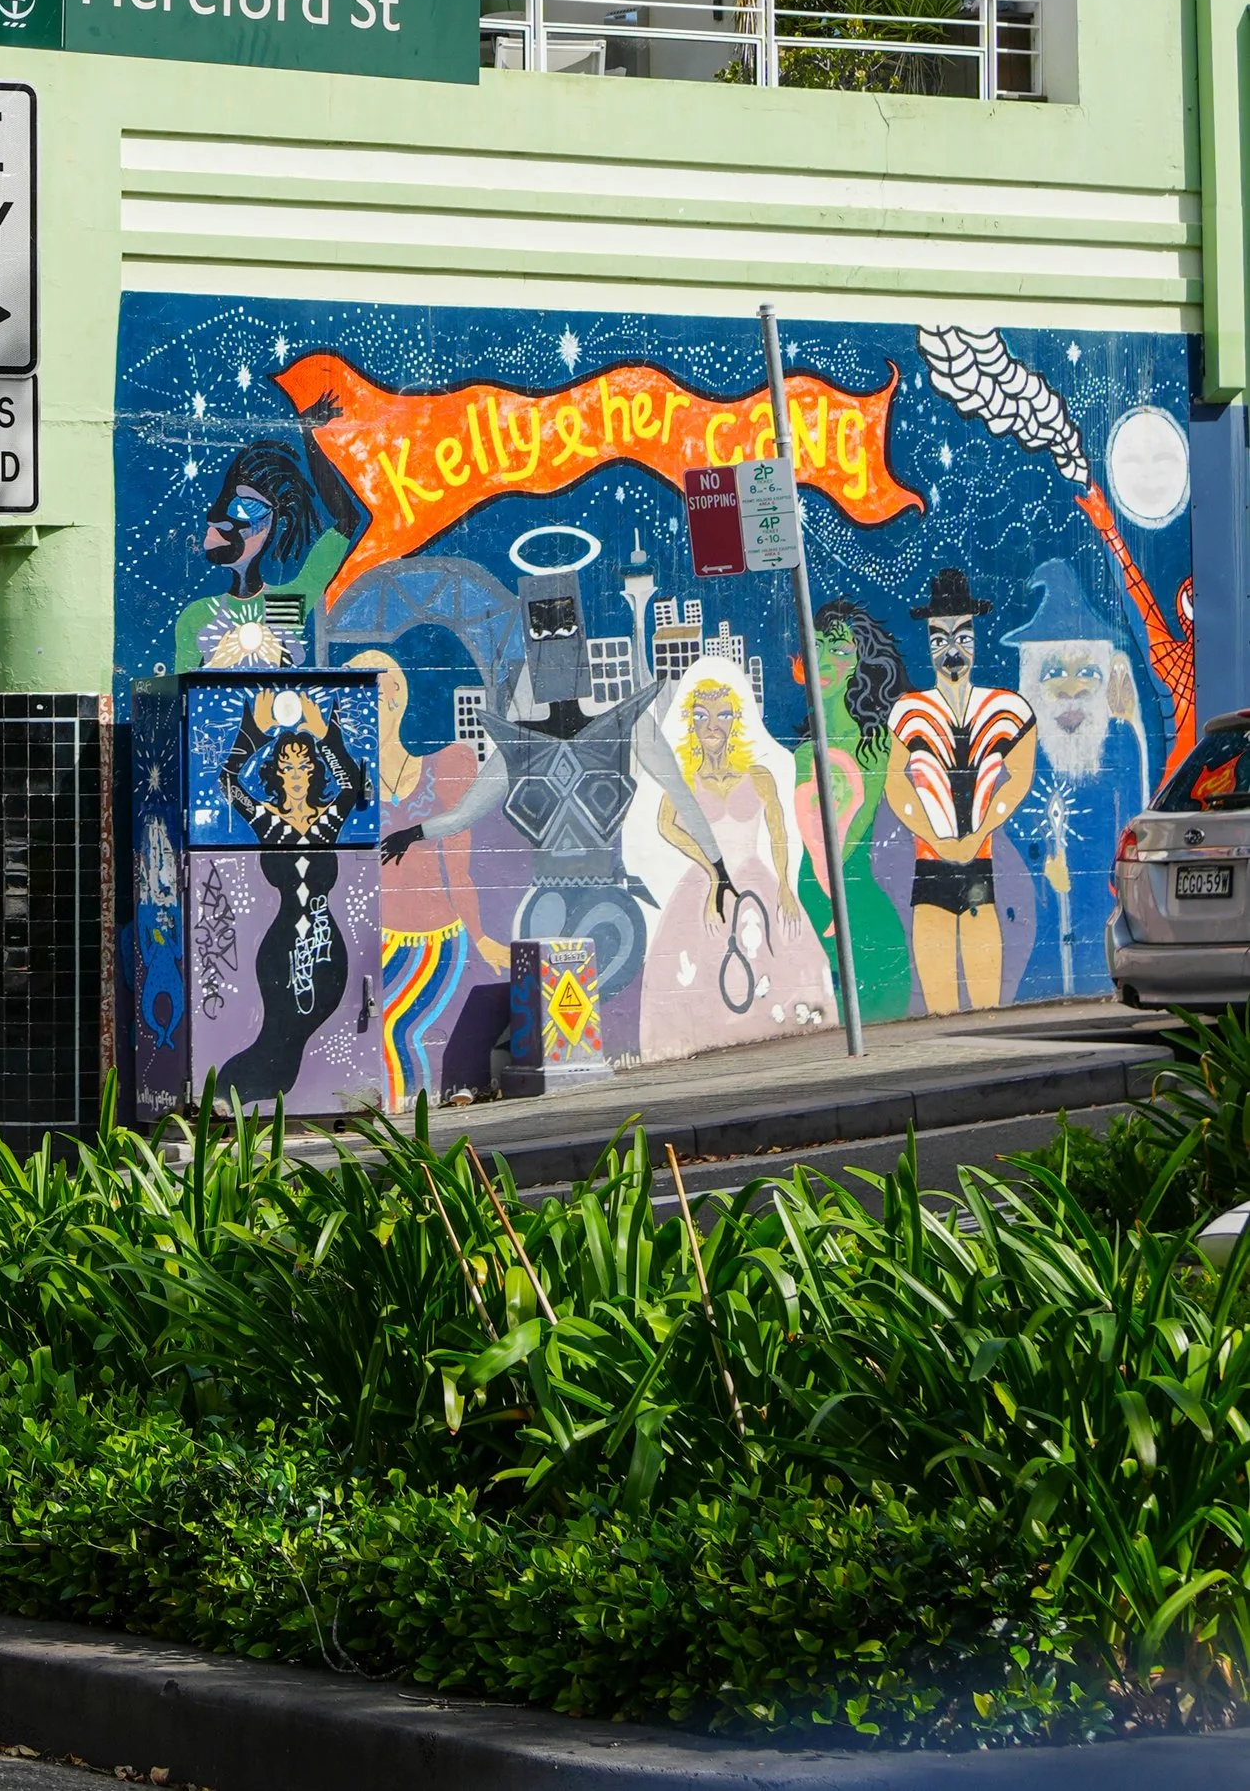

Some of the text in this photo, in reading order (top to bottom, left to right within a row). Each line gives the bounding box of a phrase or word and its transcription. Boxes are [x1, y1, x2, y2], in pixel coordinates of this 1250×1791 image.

[378, 396, 540, 524] Kelly
[598, 377, 691, 444] her
[699, 473, 720, 490] NO
[753, 466, 774, 481] 2P
[688, 492, 737, 510] STOPPING
[759, 516, 780, 530] 4P
